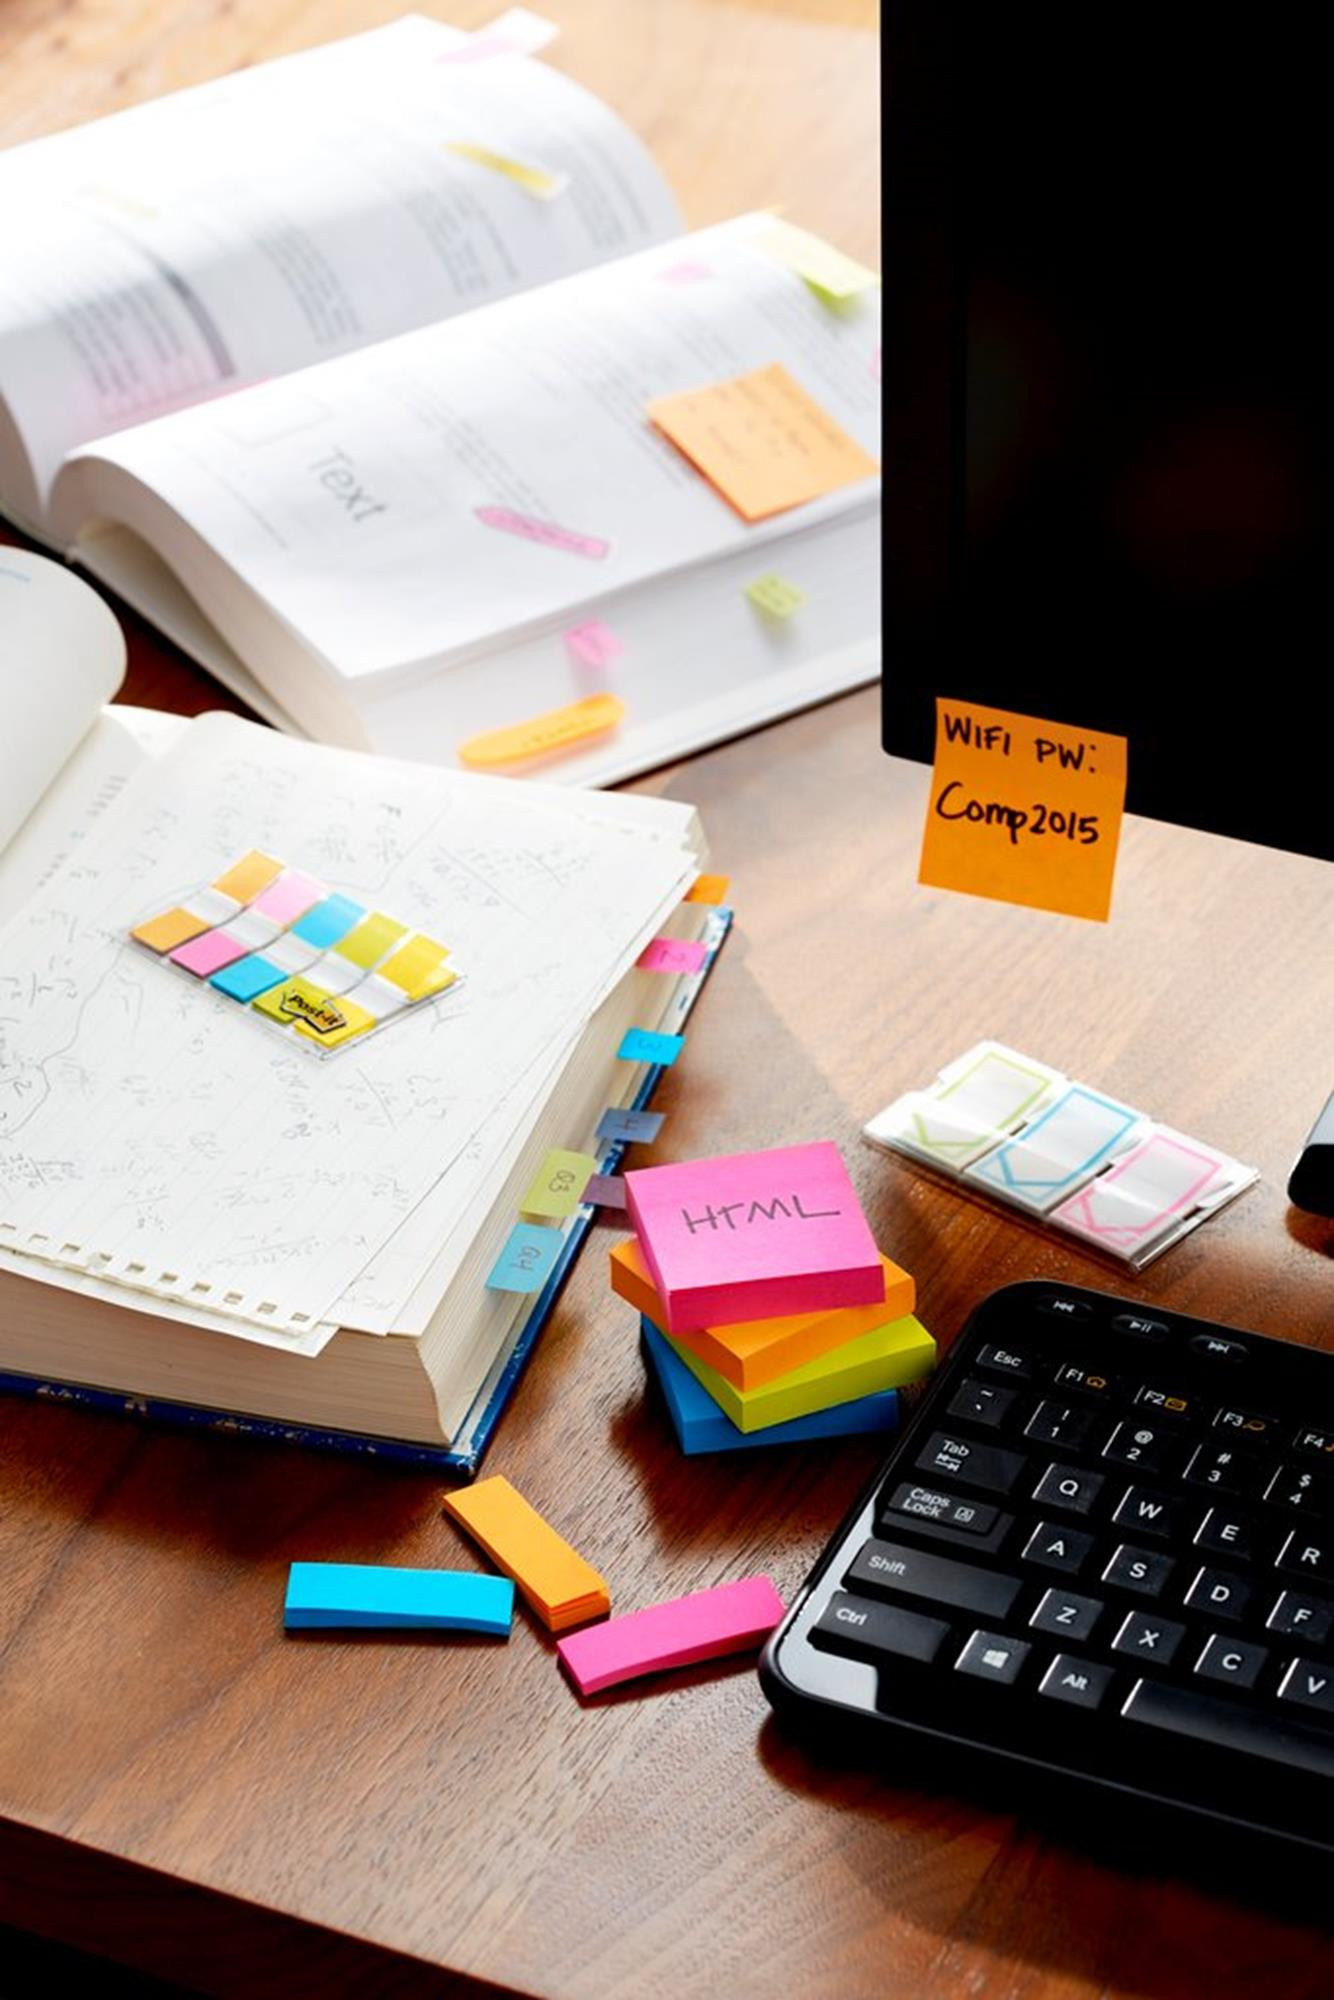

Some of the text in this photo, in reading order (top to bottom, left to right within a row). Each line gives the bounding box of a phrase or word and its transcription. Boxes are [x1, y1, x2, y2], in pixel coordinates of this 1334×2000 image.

[307, 444, 388, 522] Text
[944, 713, 1096, 773] WIFI PW:
[936, 781, 1099, 845] Comp2015
[287, 993, 340, 1026] Post-it
[682, 1195, 841, 1234] HTML
[993, 1350, 1022, 1367] Esc
[1065, 1368, 1084, 1382] F1
[1143, 1390, 1166, 1405] F2
[1223, 1411, 1244, 1427] F3
[1134, 1430, 1153, 1444] @
[1303, 1433, 1324, 1448] F4
[942, 1440, 970, 1457] Tab
[1126, 1448, 1141, 1460] 2
[1217, 1453, 1232, 1464] #
[1208, 1470, 1221, 1483] 3
[1059, 1480, 1079, 1496] Q
[909, 1487, 950, 1508] Caps
[1289, 1492, 1302, 1504] 4
[902, 1499, 942, 1518] Lock
[1138, 1501, 1163, 1519] W
[1220, 1524, 1239, 1541] E
[1046, 1540, 1065, 1556] A
[1301, 1547, 1321, 1565] R
[867, 1555, 906, 1577] Shift
[1129, 1562, 1147, 1578] S
[1210, 1585, 1230, 1602] D
[835, 1607, 868, 1626] Ctrl
[1056, 1606, 1077, 1624] Z
[1293, 1608, 1312, 1623] F
[1138, 1629, 1160, 1648] X
[1221, 1653, 1242, 1670] C
[1061, 1674, 1088, 1690] Alt
[1307, 1676, 1326, 1694] V
